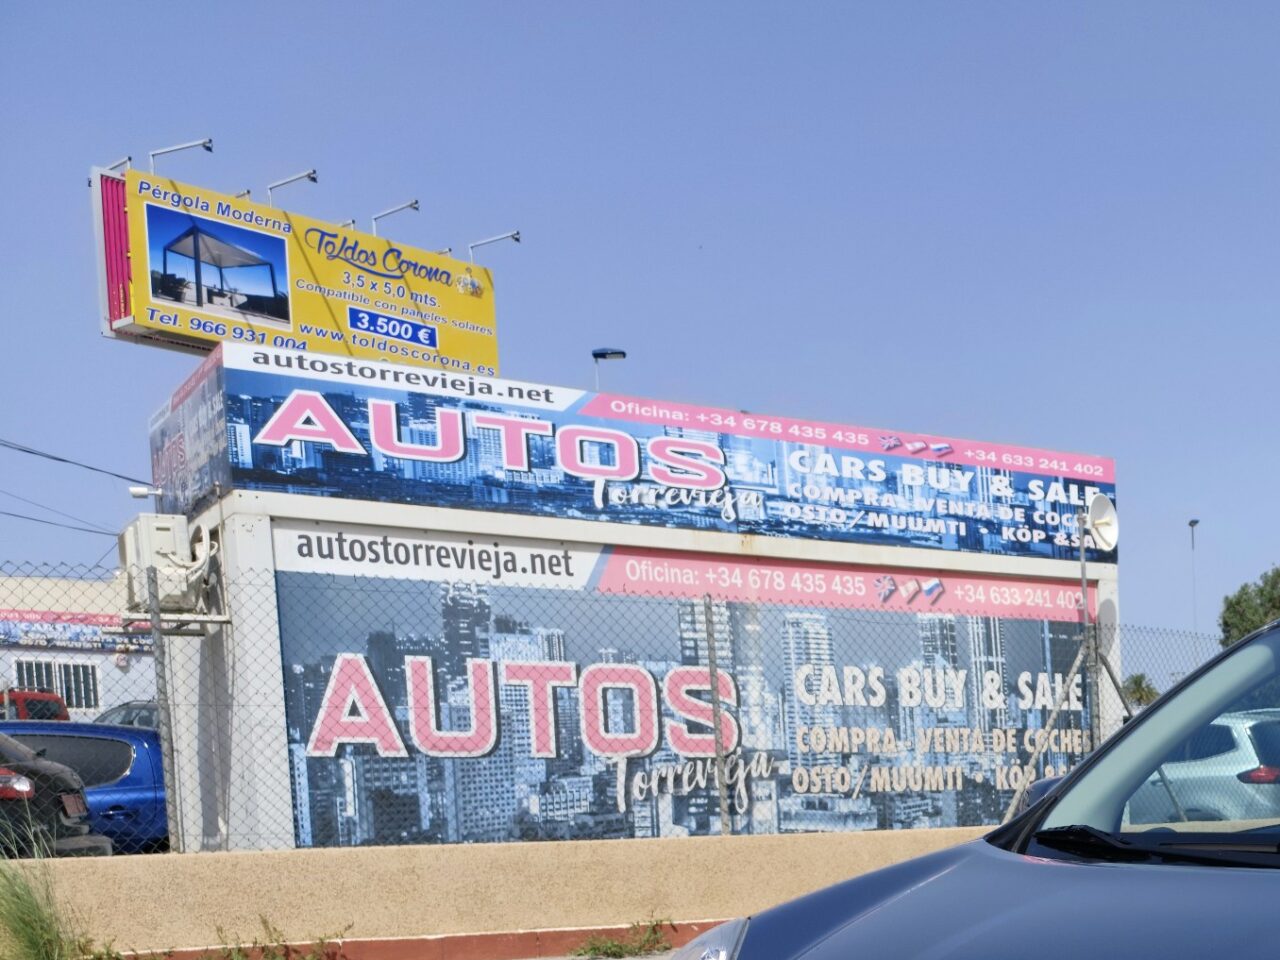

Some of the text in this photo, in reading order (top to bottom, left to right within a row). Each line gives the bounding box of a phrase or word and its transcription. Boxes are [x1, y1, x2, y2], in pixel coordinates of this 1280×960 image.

[139, 180, 293, 233] Pérgola Moderna
[304, 227, 453, 287] Toldos Corona
[296, 278, 494, 336] Compatible con paneles solares
[343, 271, 442, 308] 3,5 x 5,0 mts.
[146, 306, 309, 351] Tel. 966 931 004
[299, 323, 496, 378] www.toldoscorona.es
[356, 311, 432, 345] 3.500 €
[252, 349, 555, 405] autostorrevieja.net
[253, 388, 727, 491] AUTOS
[610, 399, 1104, 477] Oficina: +34 678 435 435 +34 633 241 402
[789, 450, 886, 482] CARS
[902, 463, 975, 493] BUY
[990, 475, 1016, 498] &
[588, 477, 765, 523] Torrevieja
[788, 483, 897, 508] COMPRA
[922, 499, 989, 520] VENTA
[998, 505, 1025, 523] DE
[297, 530, 576, 580] autostorrevieja.net
[1002, 524, 1046, 545] KÖP
[625, 559, 1086, 610] Oficina: +34 678 435 435 +34 633 241 402
[306, 651, 739, 758] AUTOS
[796, 663, 1084, 712] CARS BUY & SALE
[796, 726, 897, 753] COMPRA
[918, 727, 984, 753] VENTA
[992, 728, 1017, 753] DE
[606, 747, 775, 815] Torrevieja
